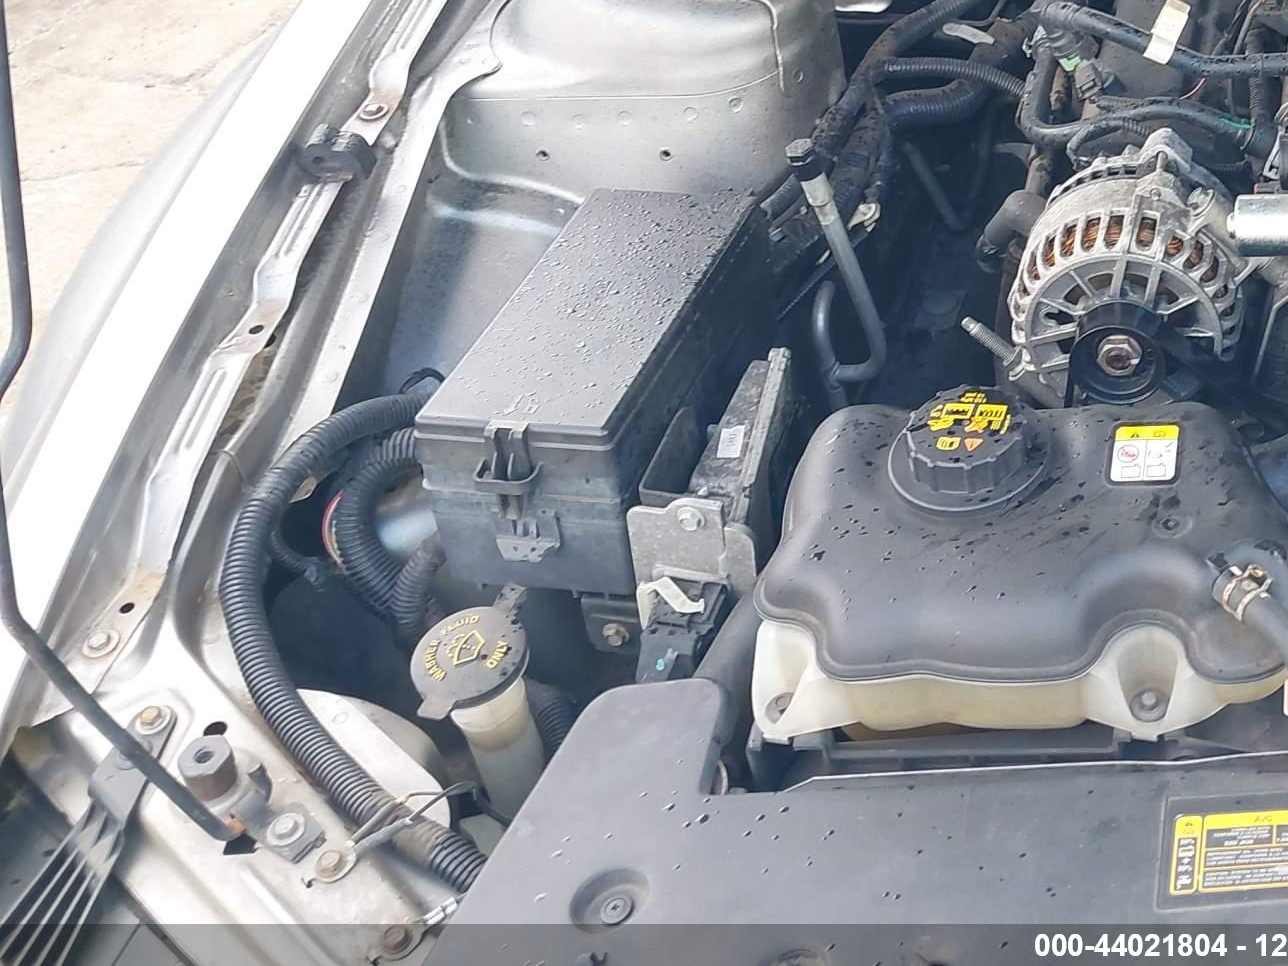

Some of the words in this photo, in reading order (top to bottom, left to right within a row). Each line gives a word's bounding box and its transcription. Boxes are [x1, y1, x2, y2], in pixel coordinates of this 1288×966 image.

[425, 639, 446, 682] WASHER
[441, 615, 480, 635] FLUID
[486, 641, 508, 669] ONLY
